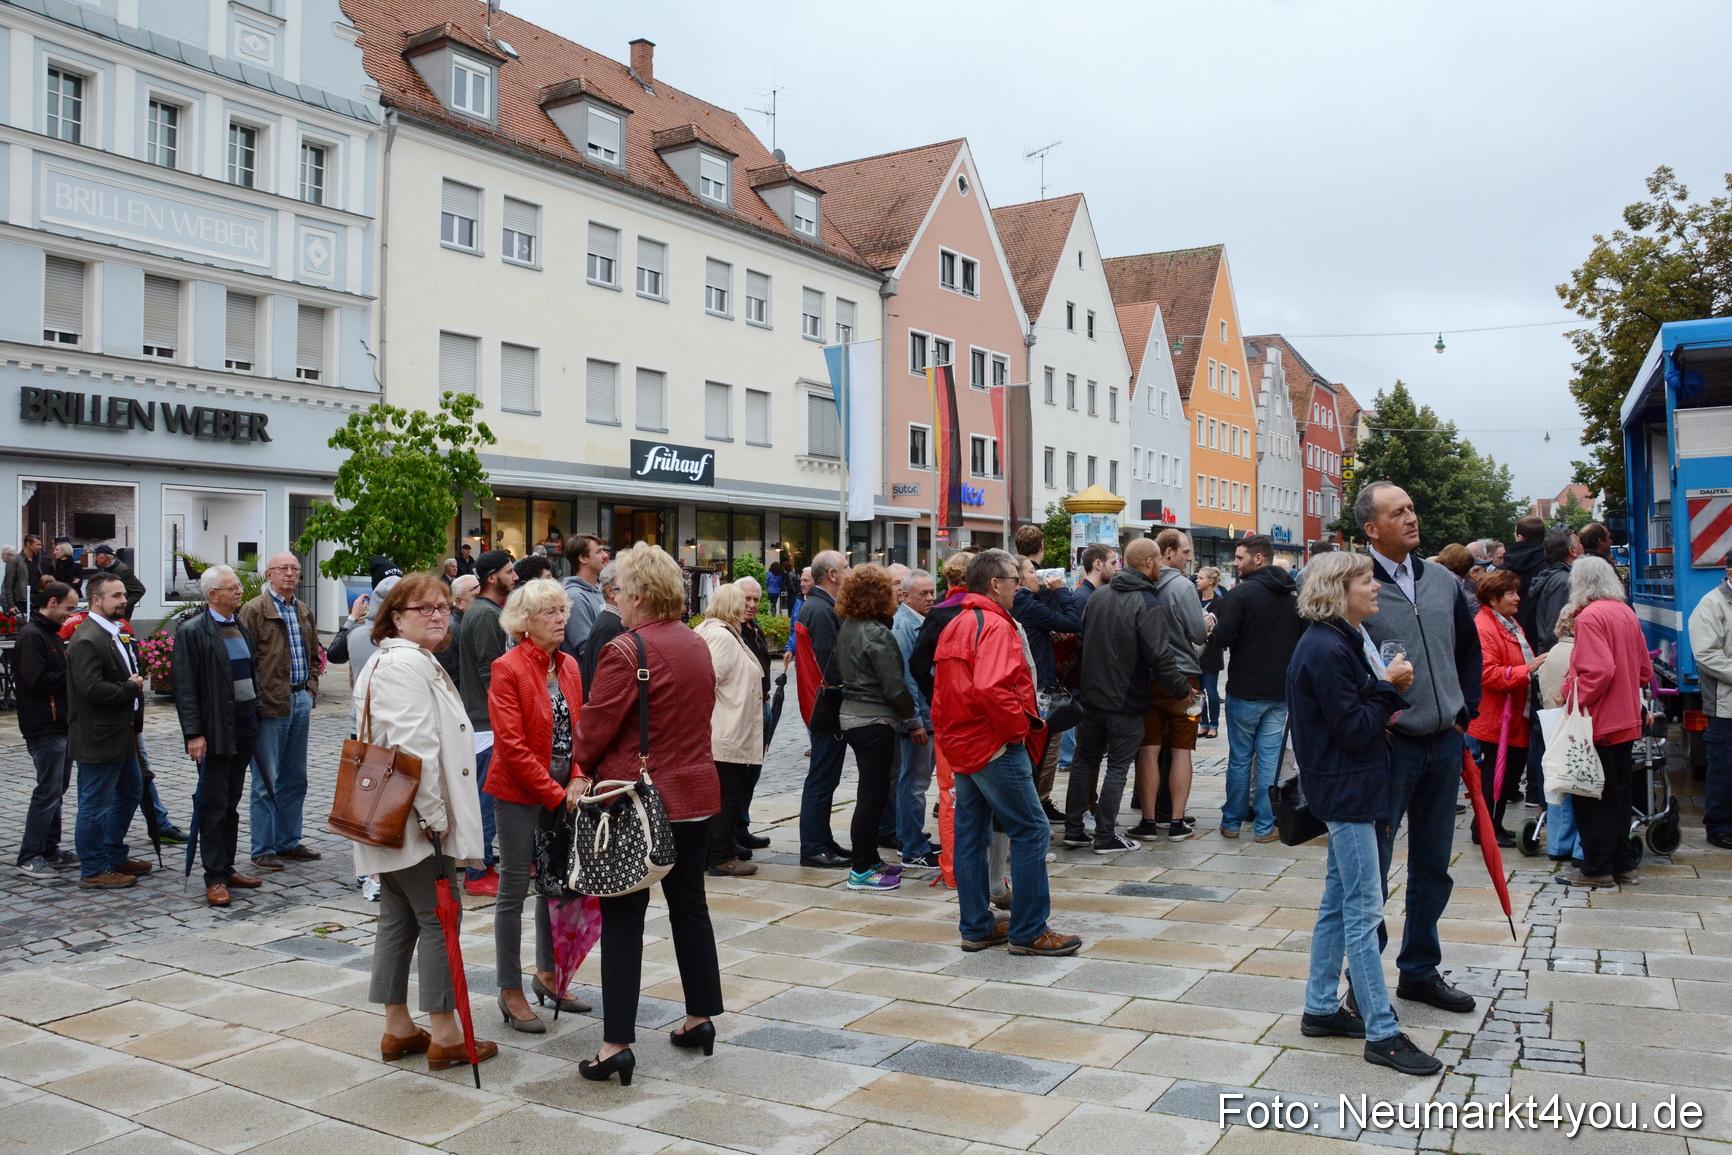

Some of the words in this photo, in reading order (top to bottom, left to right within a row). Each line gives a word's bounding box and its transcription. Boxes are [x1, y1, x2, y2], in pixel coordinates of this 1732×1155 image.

[56, 181, 164, 231] BRILLEN
[170, 208, 260, 252] WEBER
[20, 386, 156, 432] BRILLEN
[160, 402, 273, 443] WEBER
[636, 445, 713, 482] frühauf
